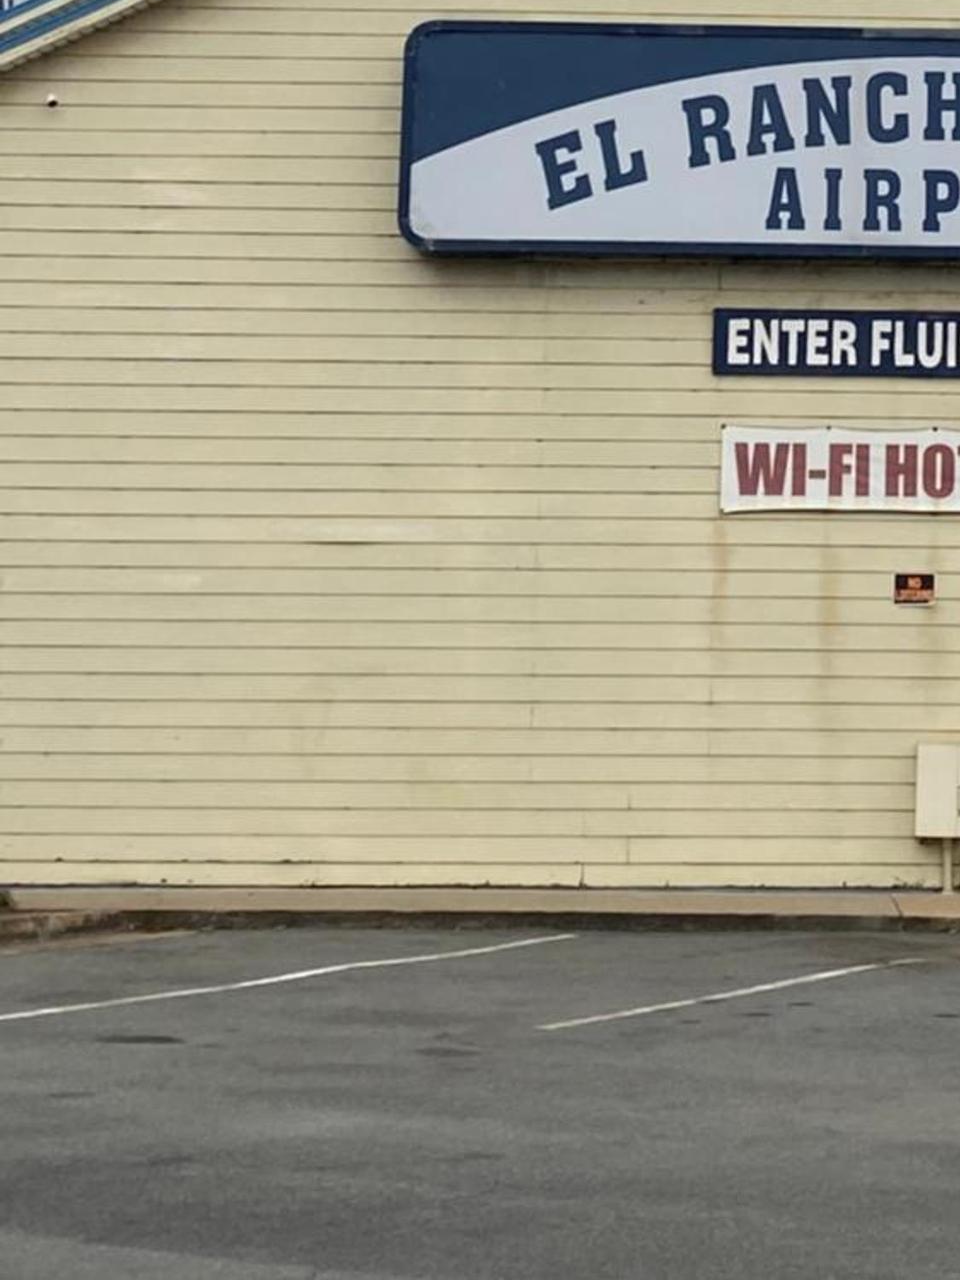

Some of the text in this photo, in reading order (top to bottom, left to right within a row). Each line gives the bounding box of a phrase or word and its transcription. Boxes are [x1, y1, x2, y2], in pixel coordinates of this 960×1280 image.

[535, 119, 648, 210] EL
[727, 318, 857, 367] ENTER
[734, 442, 871, 497] WI-FI
